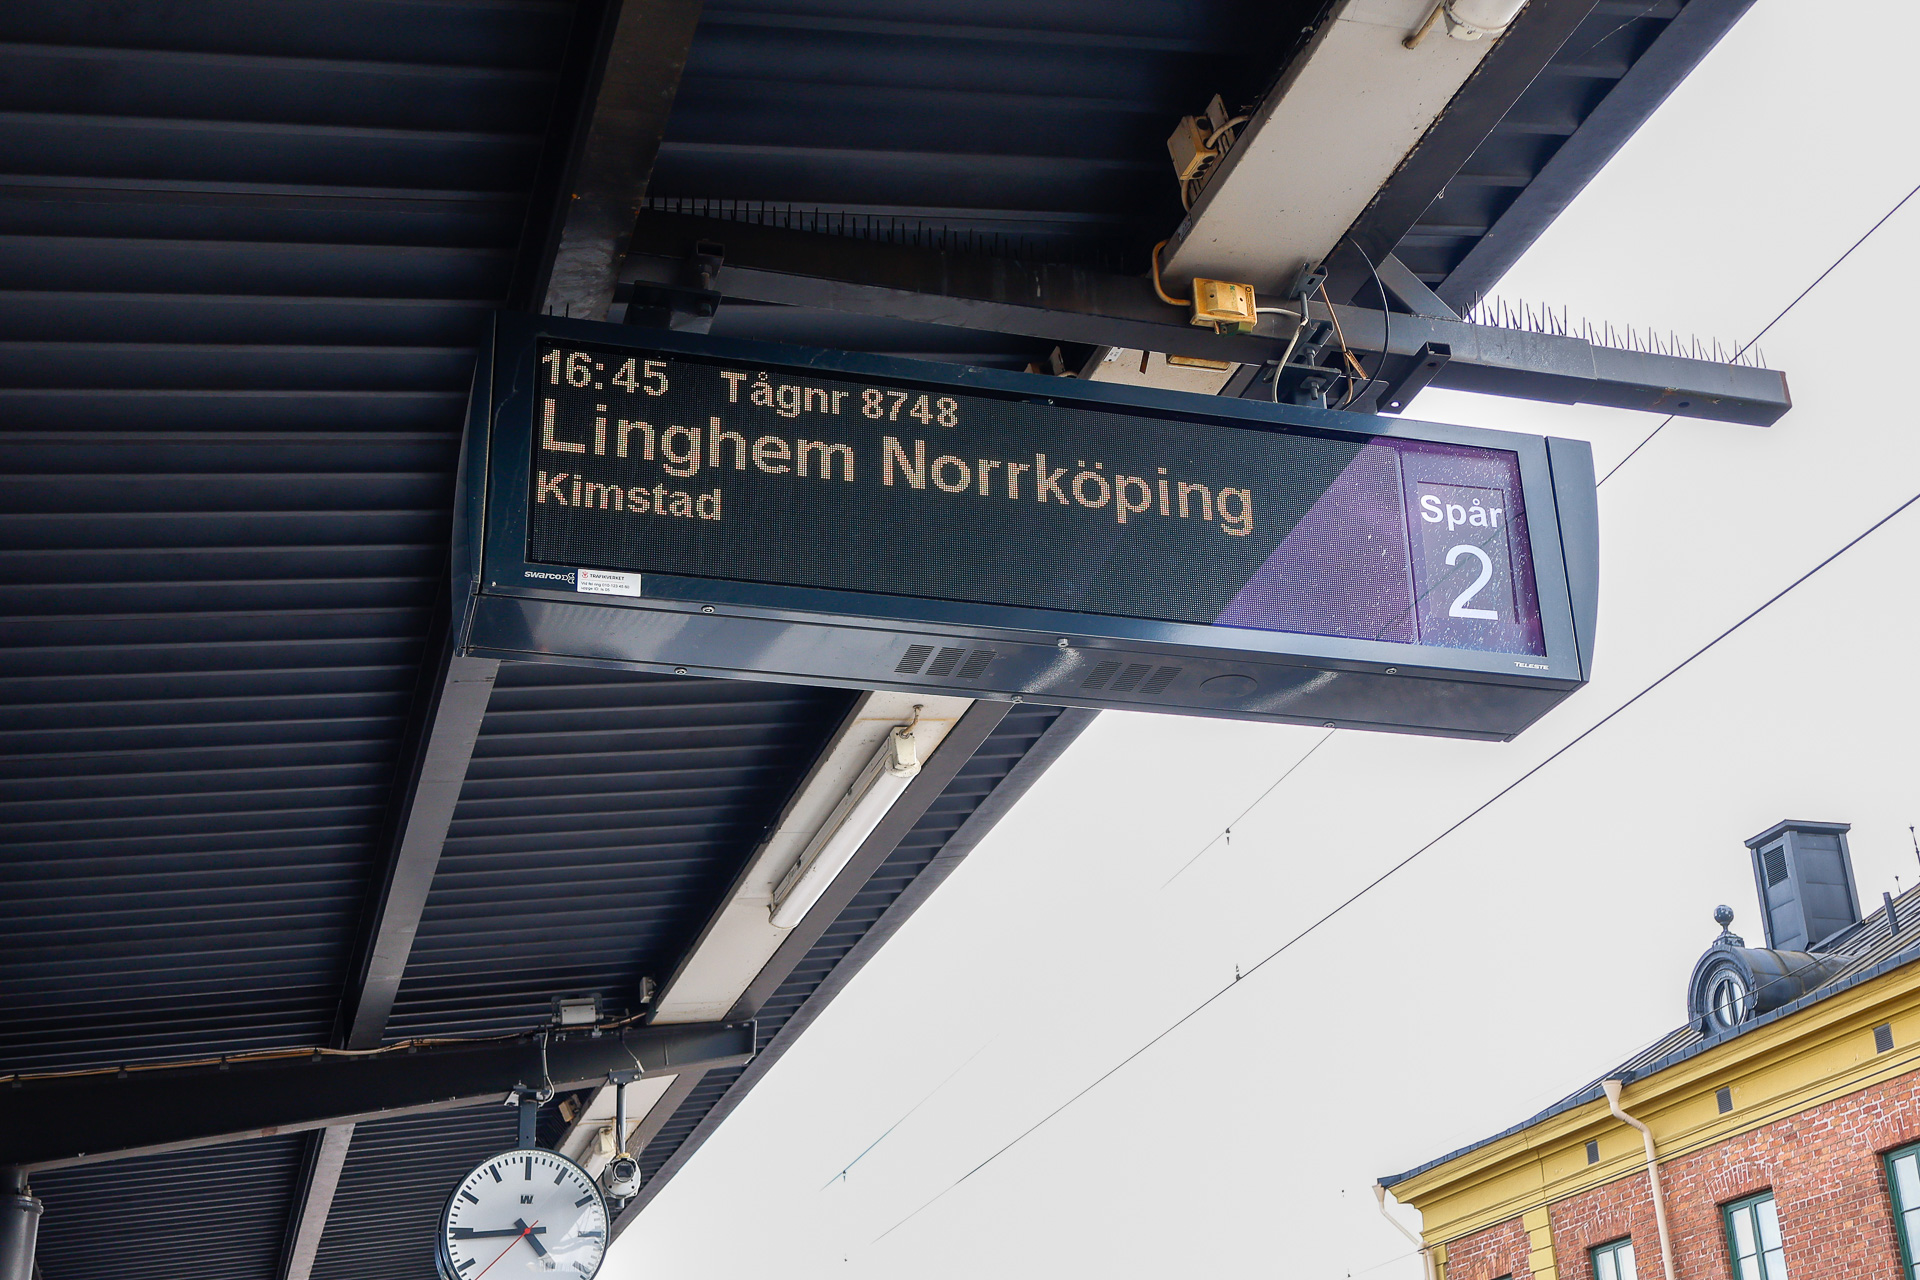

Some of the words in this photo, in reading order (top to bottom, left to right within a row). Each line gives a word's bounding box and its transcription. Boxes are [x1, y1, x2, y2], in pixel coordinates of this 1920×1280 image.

[541, 349, 669, 396] 16:45
[720, 370, 849, 417] Tågnr
[861, 388, 959, 428] 8748
[542, 398, 855, 482] Linghem
[882, 435, 1254, 536] Norrköping
[536, 470, 722, 521] Kimstad
[1420, 494, 1503, 531] Spår
[1445, 544, 1499, 621] 2
[1514, 661, 1549, 670] TELESTE
